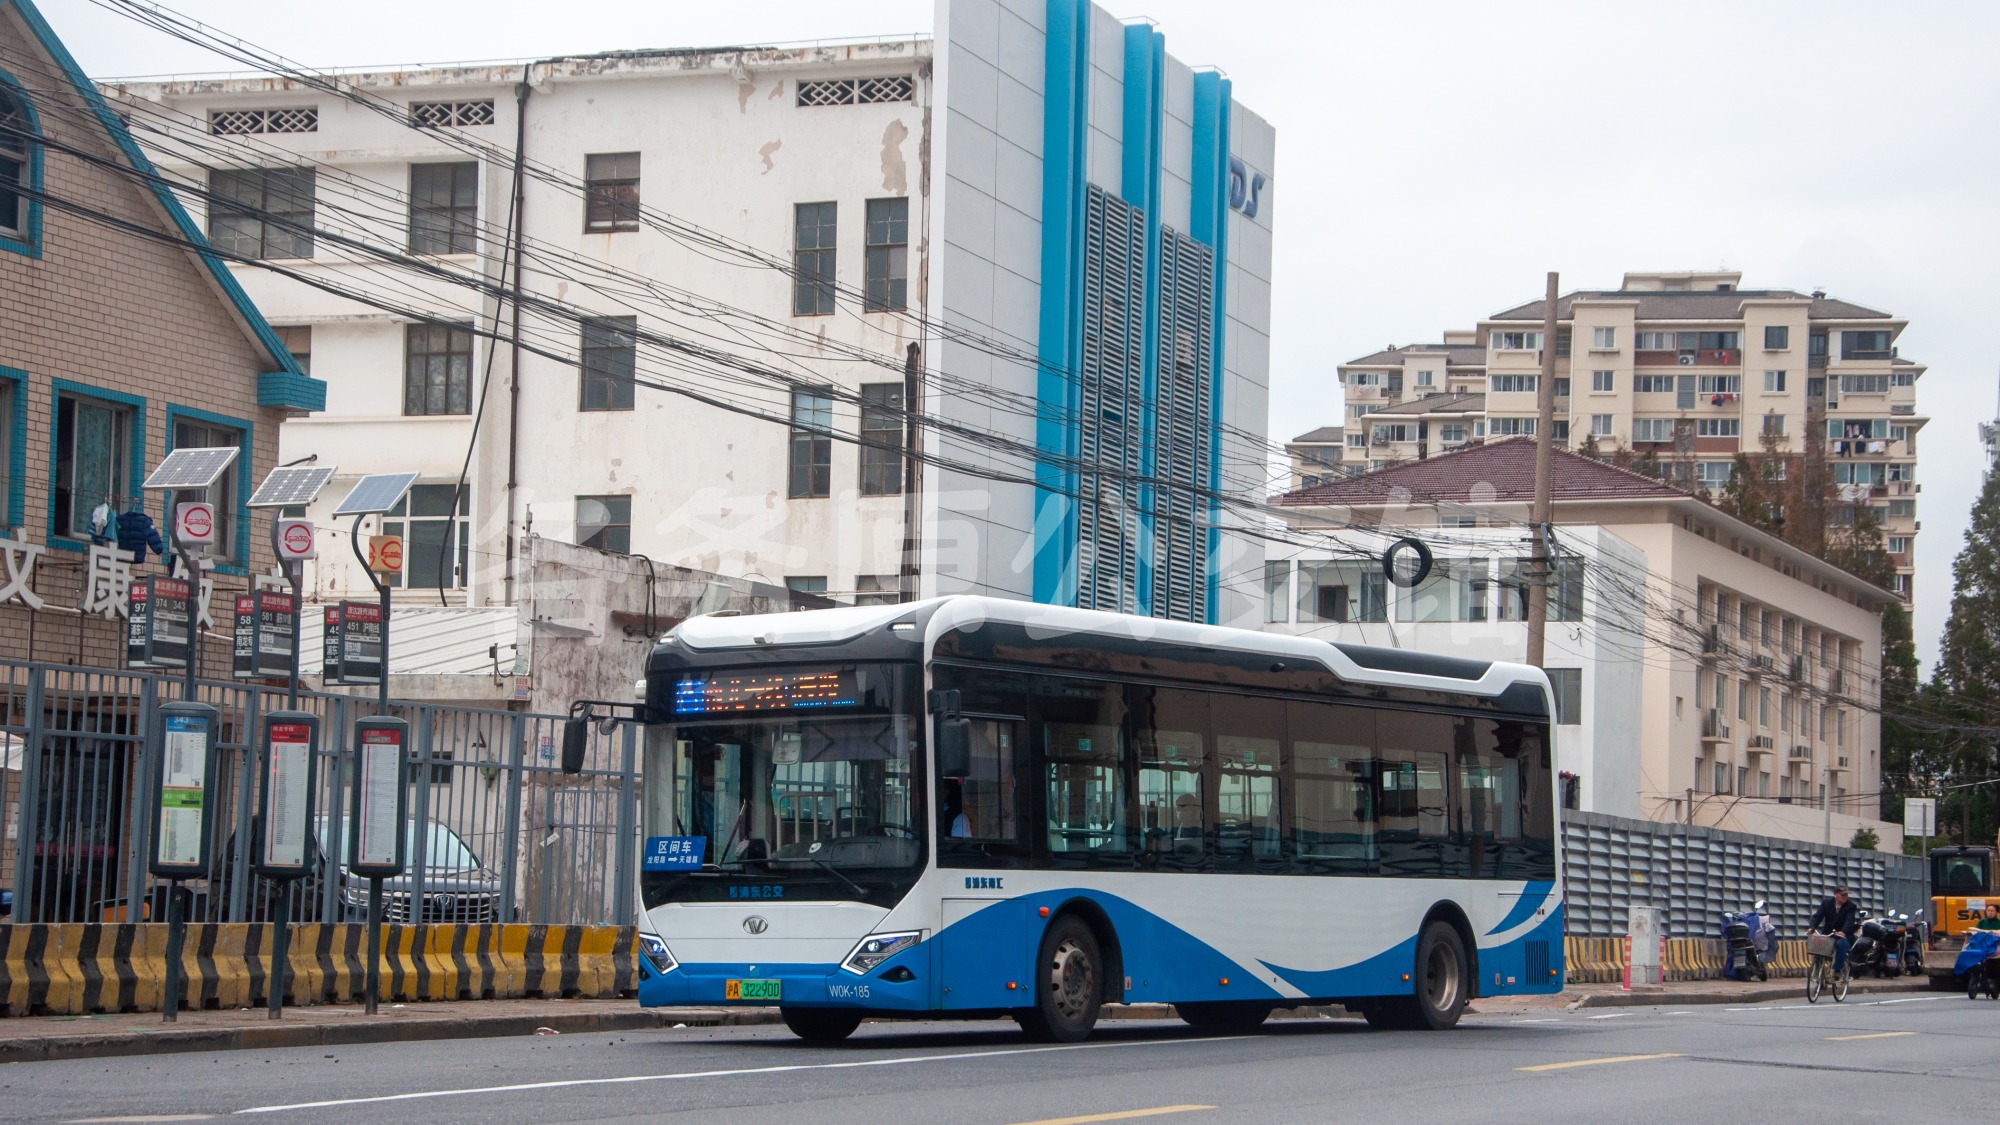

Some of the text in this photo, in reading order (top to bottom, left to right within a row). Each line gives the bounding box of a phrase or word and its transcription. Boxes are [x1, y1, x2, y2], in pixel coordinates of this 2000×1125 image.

[155, 598, 186, 611] 974 343
[262, 612, 273, 621] 581
[346, 622, 359, 631] 451
[173, 716, 189, 724] 343
[657, 840, 692, 854] 区间车
[646, 856, 666, 864] 龙阳路
[739, 885, 783, 898] 浦东公交
